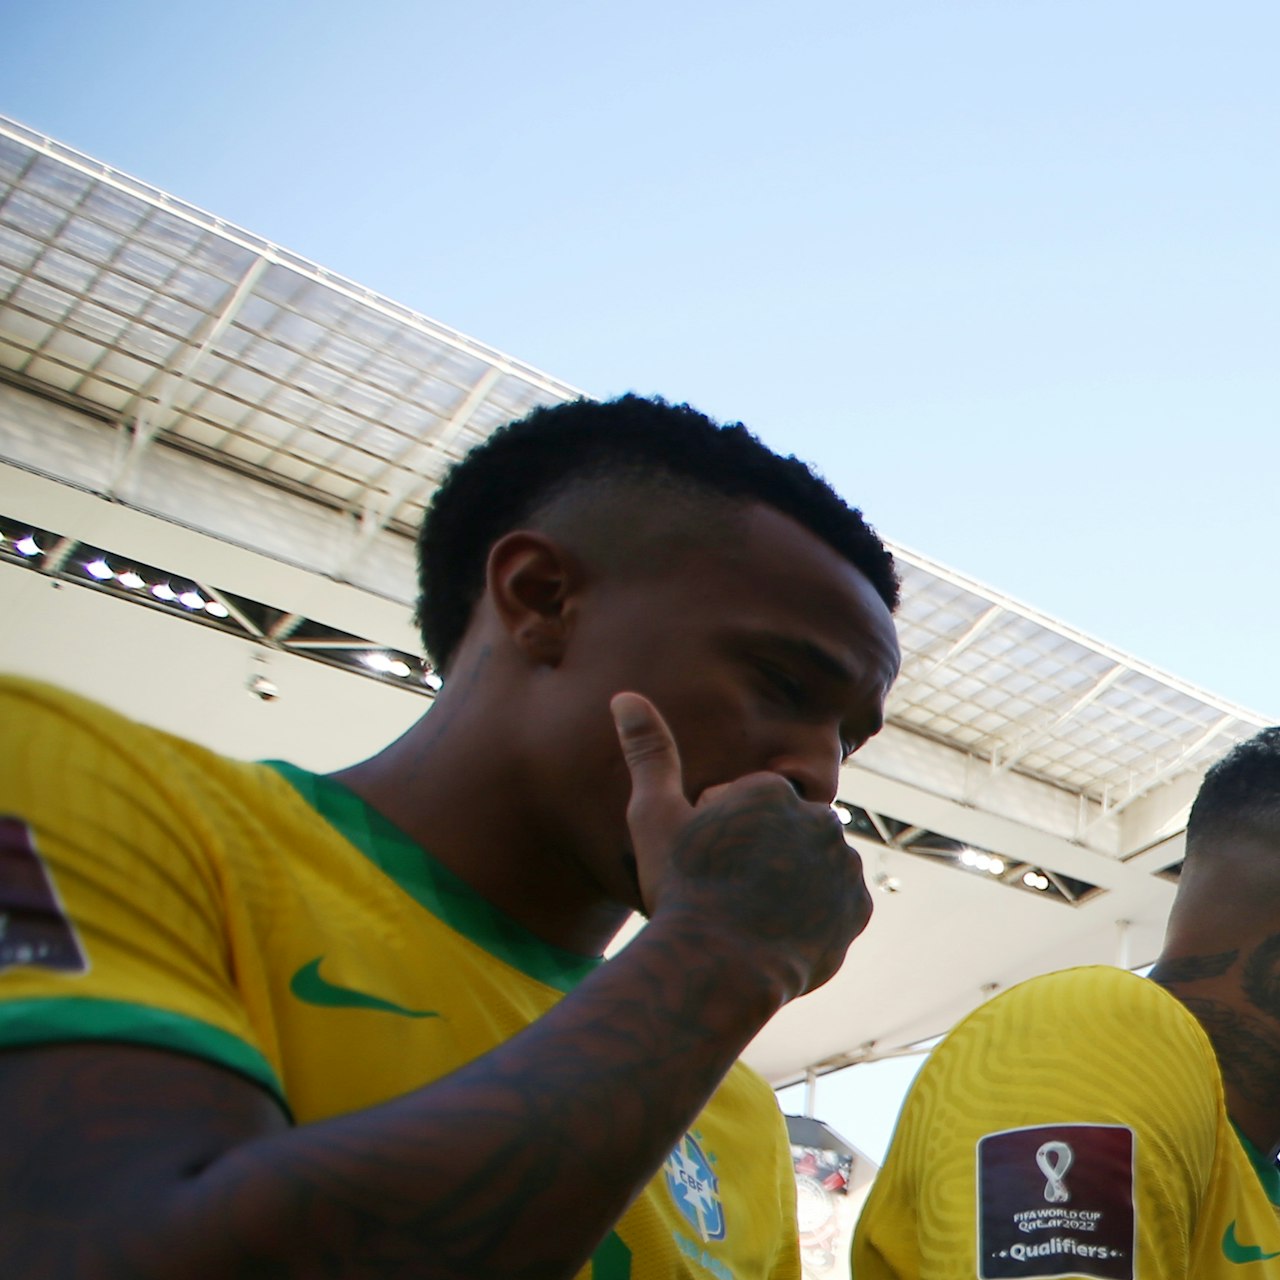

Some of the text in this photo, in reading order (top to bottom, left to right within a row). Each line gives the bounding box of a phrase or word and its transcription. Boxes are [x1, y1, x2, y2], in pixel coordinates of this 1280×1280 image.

[1013, 1209, 1101, 1222] FIFA WORLD CUP
[1010, 1238, 1108, 1261] Qualifiers
